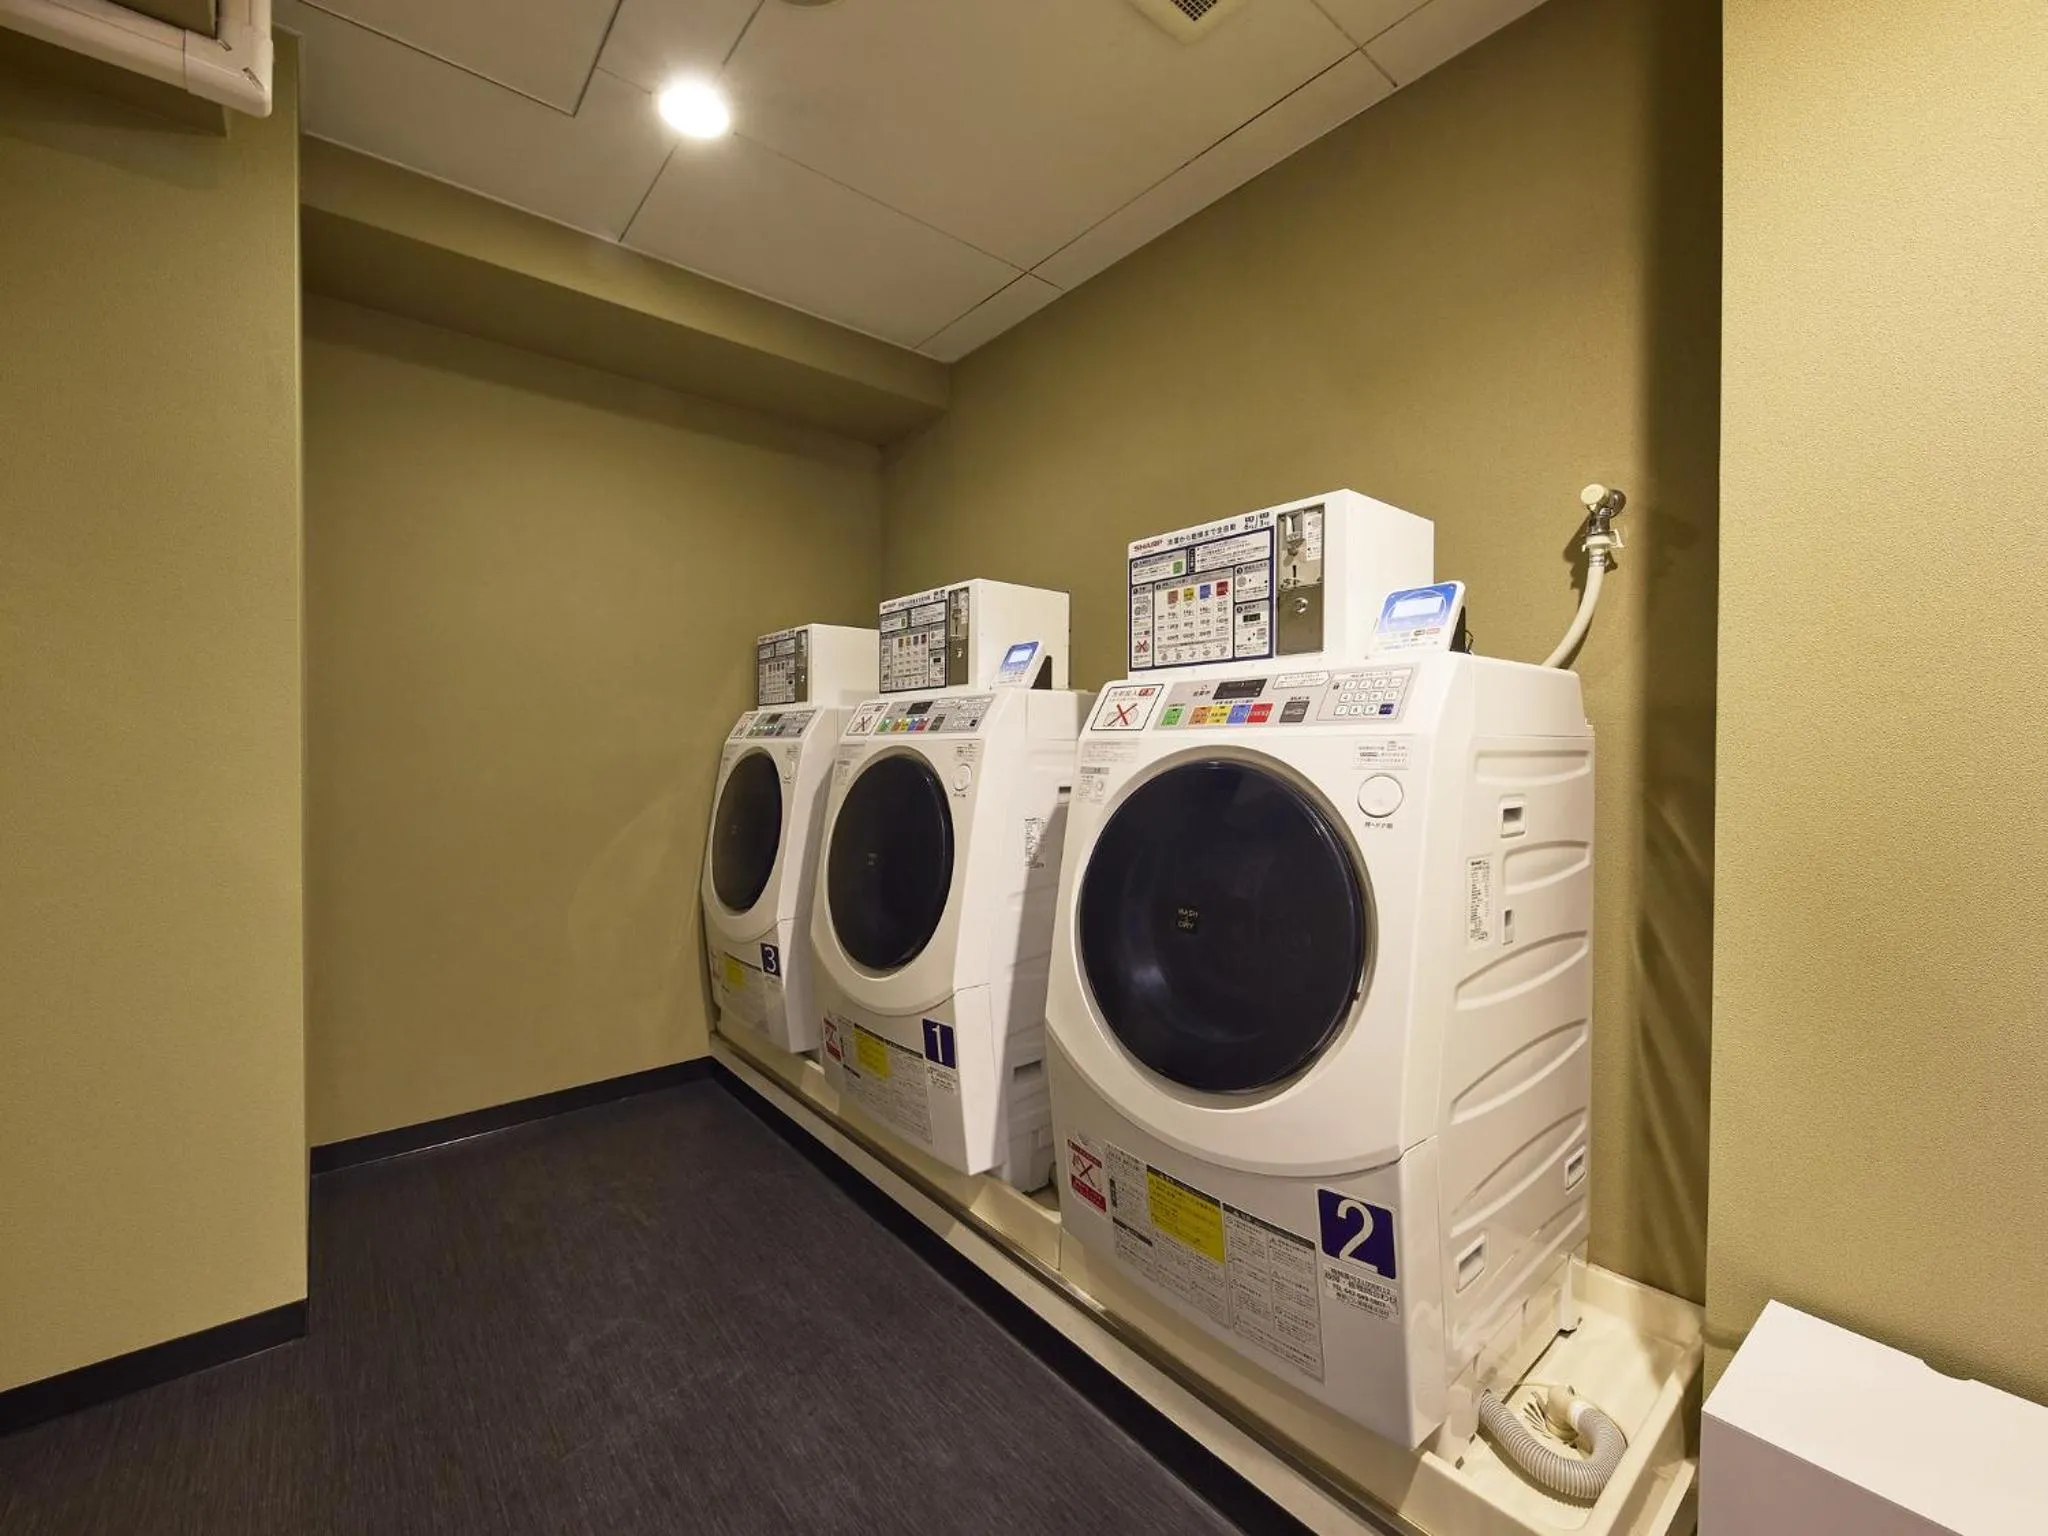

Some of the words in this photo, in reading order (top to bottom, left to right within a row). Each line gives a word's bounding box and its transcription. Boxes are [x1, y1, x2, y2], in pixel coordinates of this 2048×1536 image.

[763, 946, 777, 973] 3
[931, 1024, 944, 1063] 1
[1337, 1198, 1379, 1275] 2
